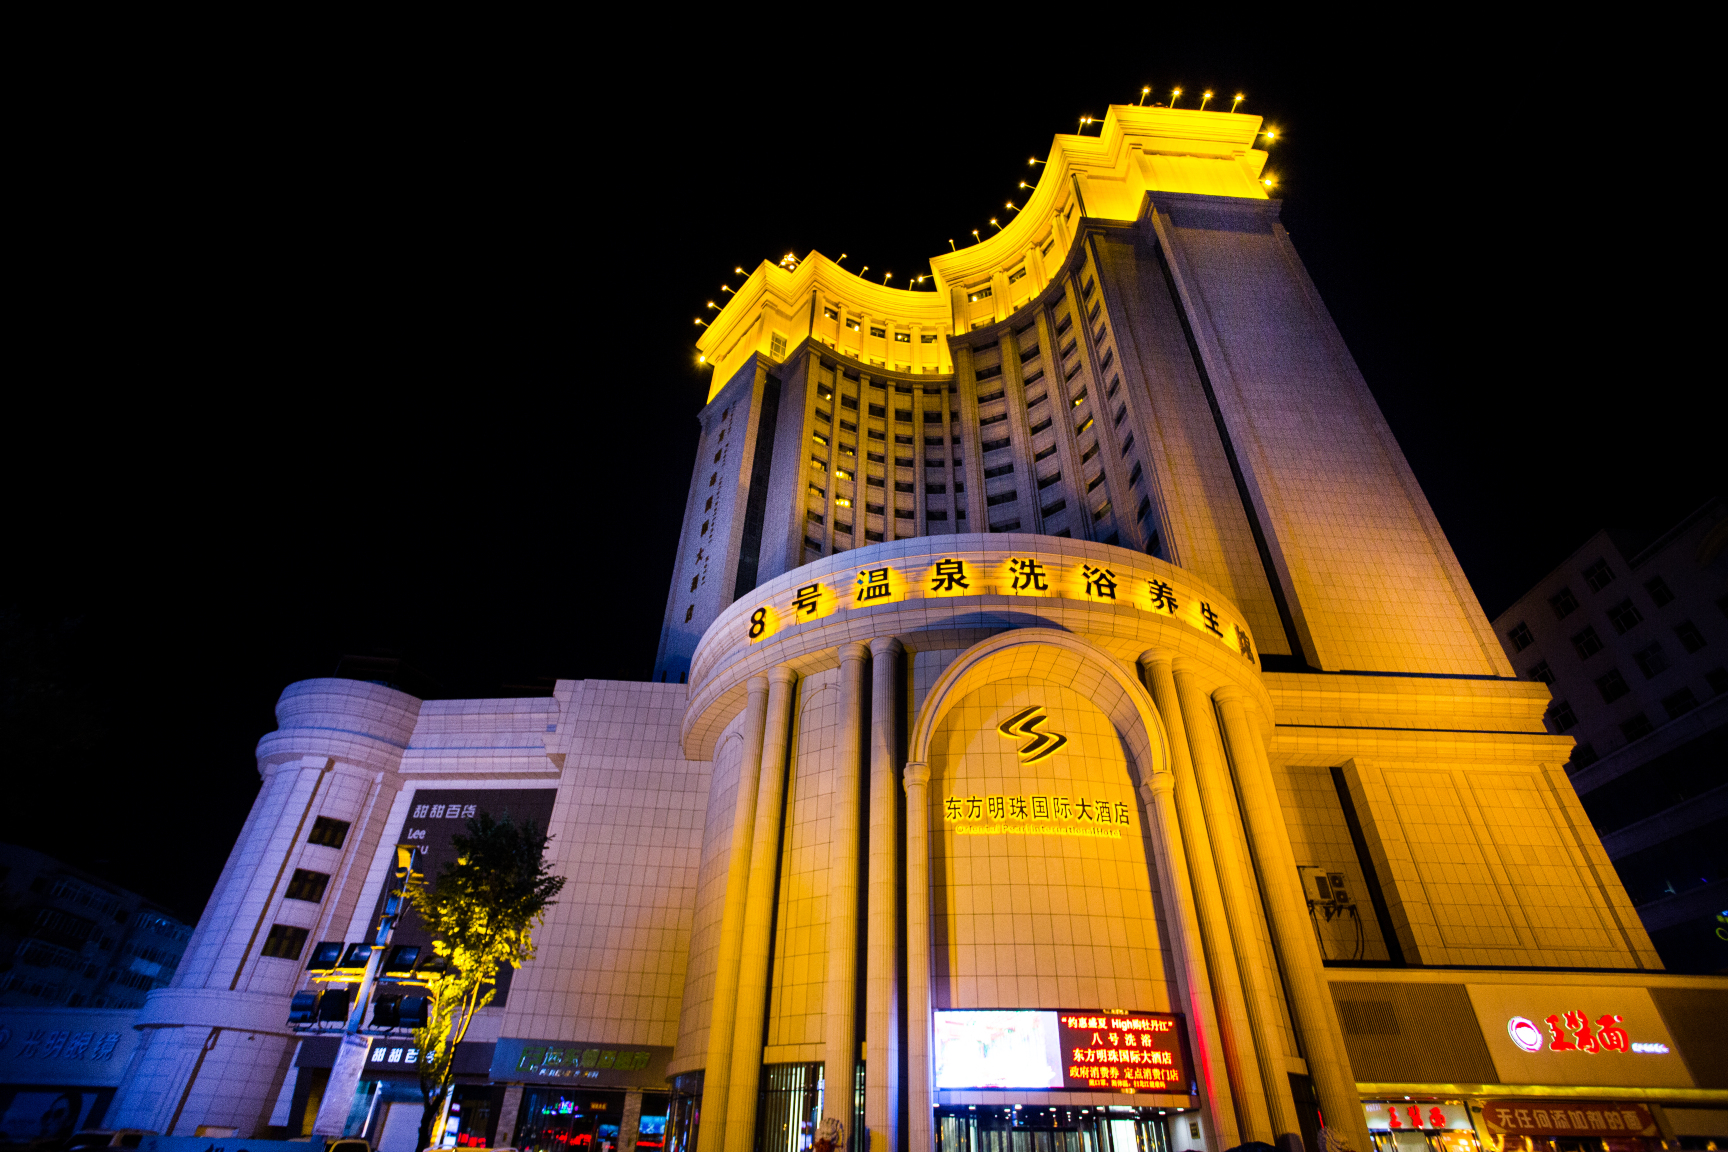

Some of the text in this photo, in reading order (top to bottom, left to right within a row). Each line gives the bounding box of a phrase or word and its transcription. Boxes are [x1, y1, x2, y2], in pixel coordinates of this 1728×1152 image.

[412, 804, 478, 819] 甜甜百货
[945, 795, 1131, 825] 东方明珠国际大酒店
[407, 828, 427, 840] Lee
[955, 824, 1122, 839] Oriental Pearl International Hotel
[15, 1029, 122, 1062] 光明眼镜
[1091, 1032, 1152, 1047] 八号洗浴
[1072, 1048, 1172, 1065] 东方明珠国际大酒店
[1069, 1066, 1179, 1082] 政府消费券 定点消费门店
[1495, 1108, 1644, 1131] 无任何添加剂的面
